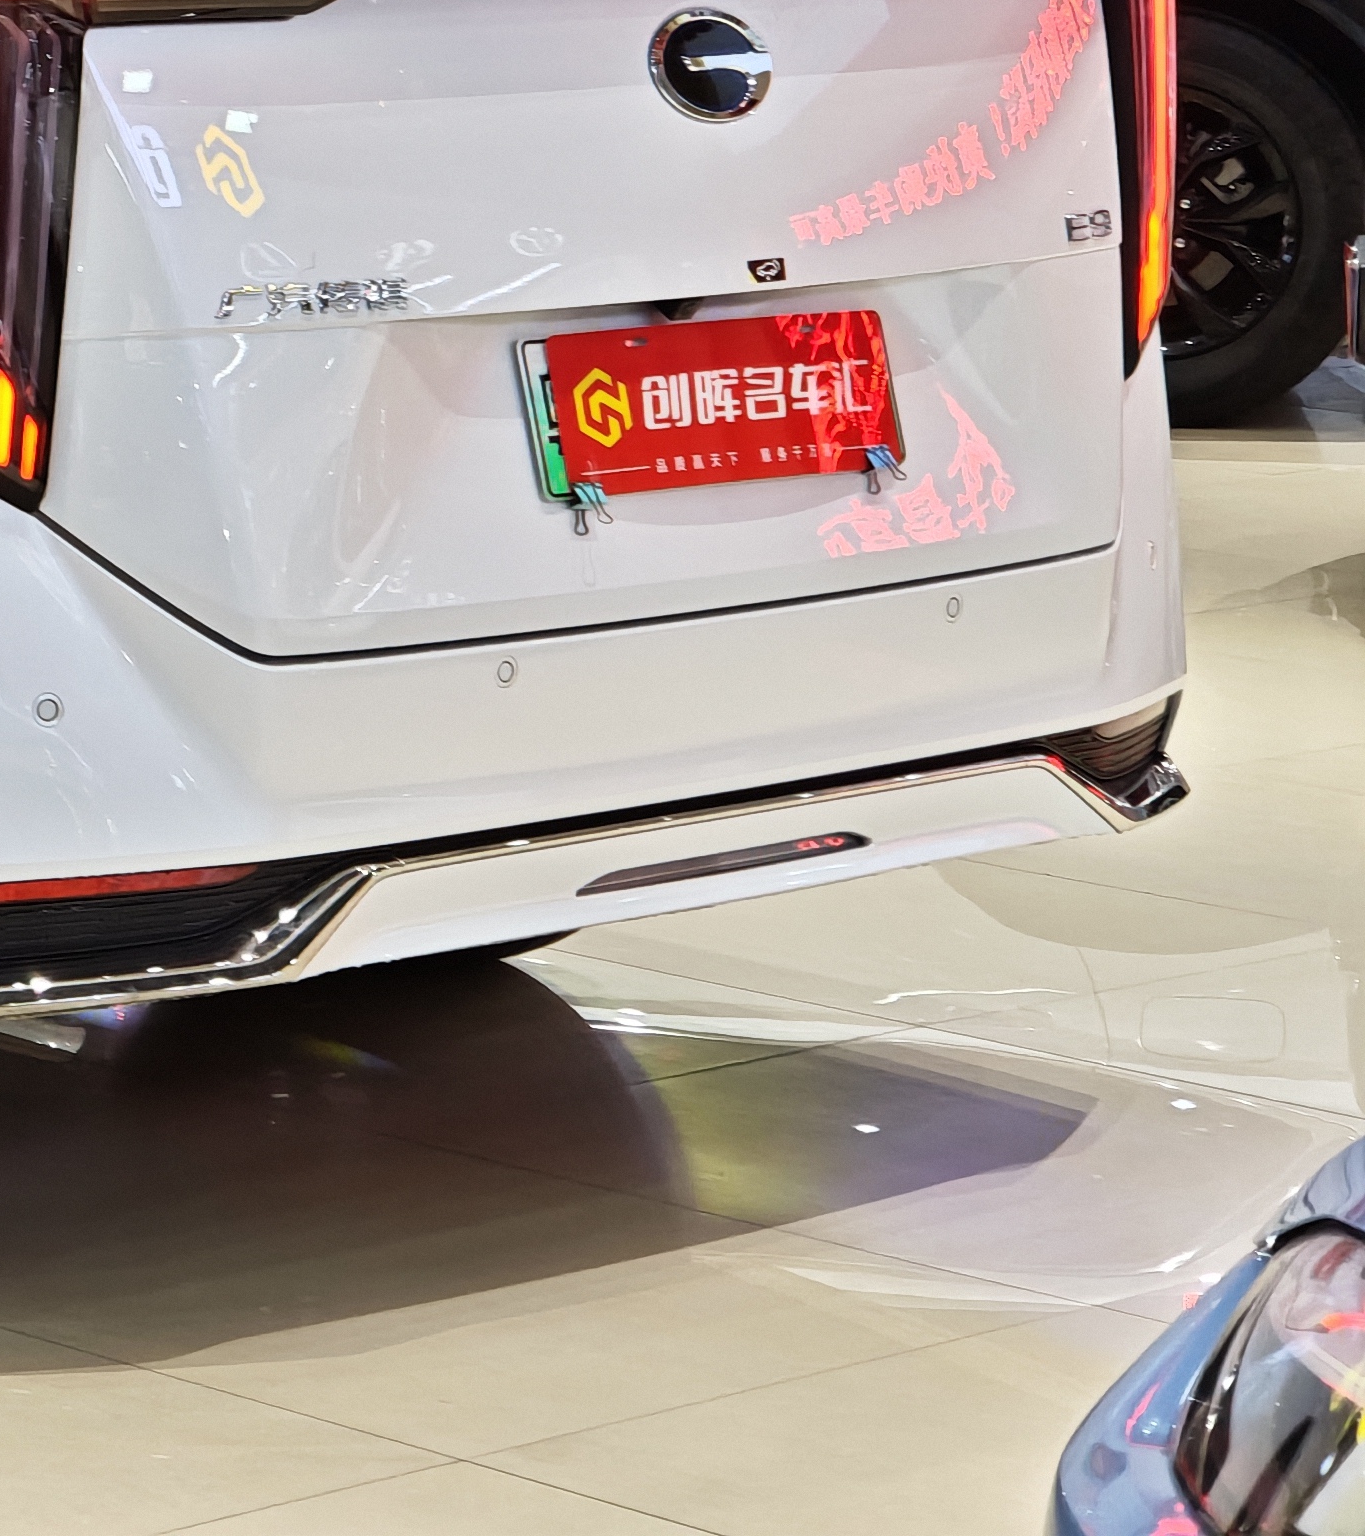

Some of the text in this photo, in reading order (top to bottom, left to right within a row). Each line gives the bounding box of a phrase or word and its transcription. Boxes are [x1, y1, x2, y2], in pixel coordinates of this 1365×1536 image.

[640, 359, 873, 431] 创晖名车汇
